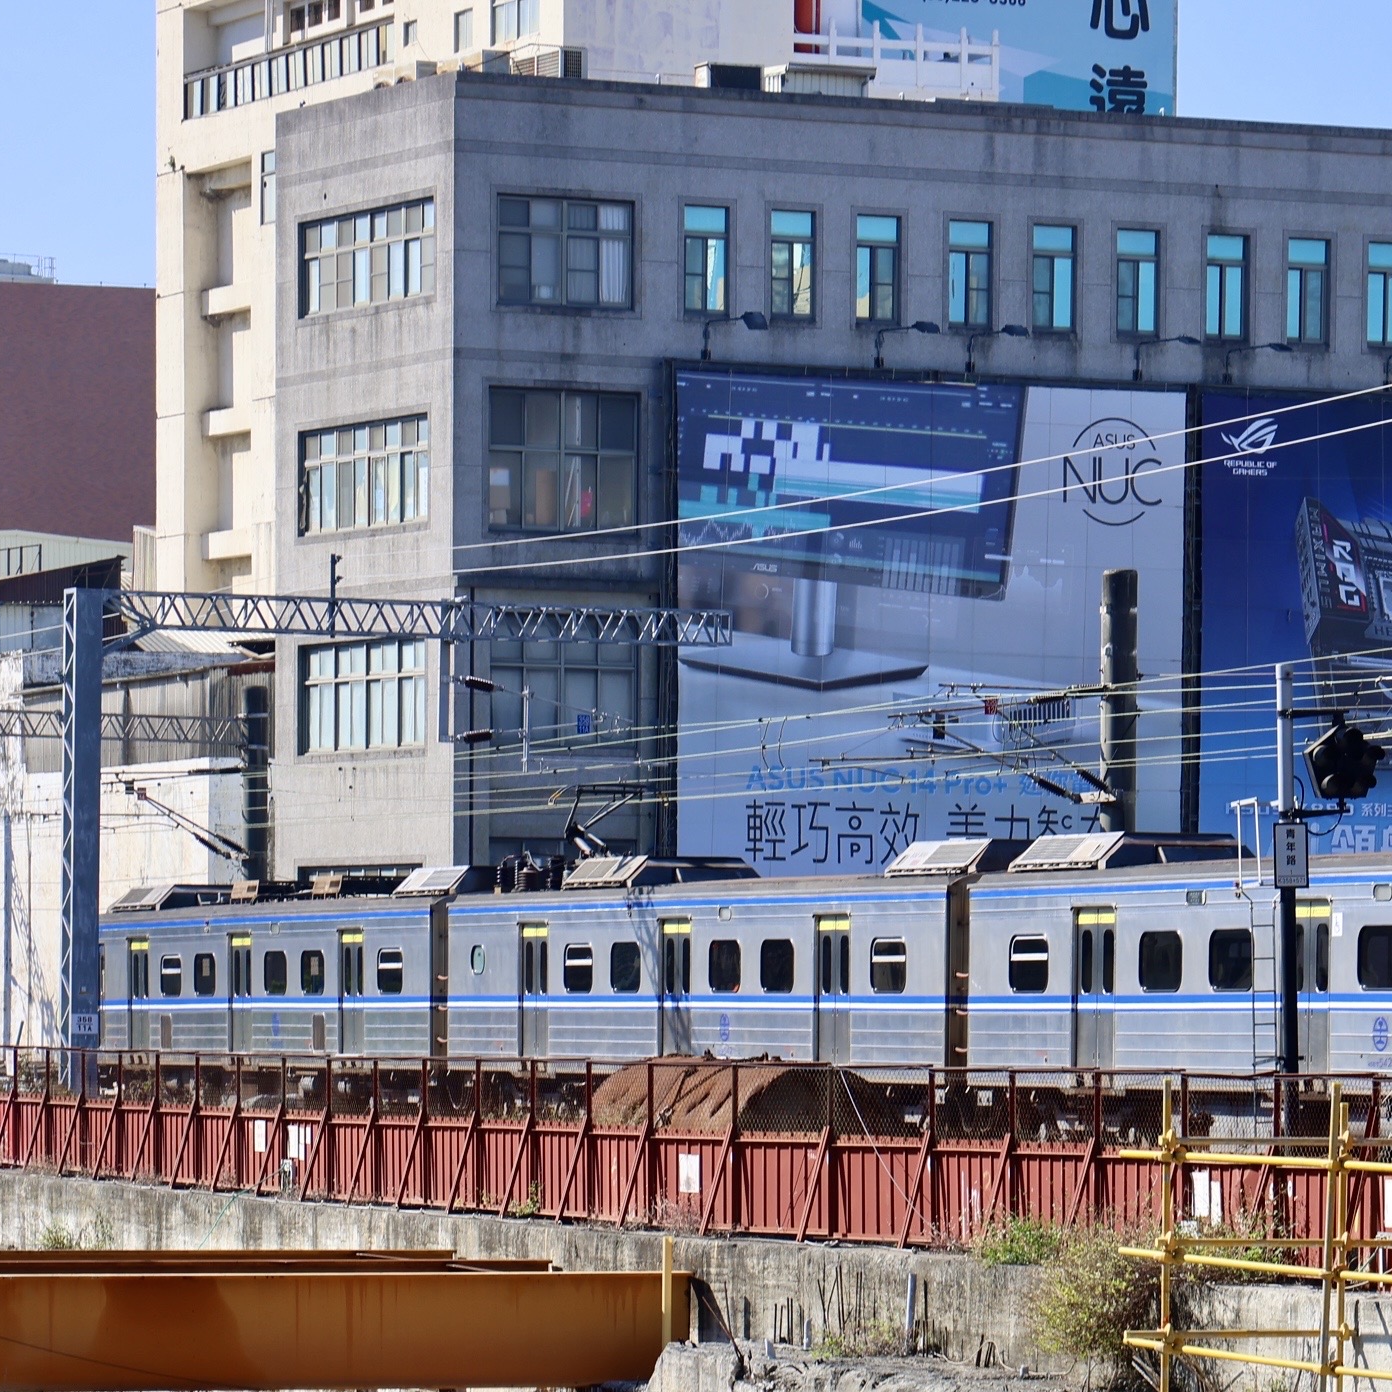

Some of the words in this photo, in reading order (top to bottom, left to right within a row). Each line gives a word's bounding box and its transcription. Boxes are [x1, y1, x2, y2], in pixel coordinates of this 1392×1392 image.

[1094, 433, 1135, 449] ASUS
[1224, 459, 1265, 469] REPUBLIC
[1266, 460, 1278, 469] OF
[1232, 468, 1268, 477] GAMERS
[1063, 456, 1162, 506] NUC
[746, 766, 826, 793] ASUS
[745, 799, 920, 865] 輕巧高效
[1286, 828, 1296, 866] 青年路
